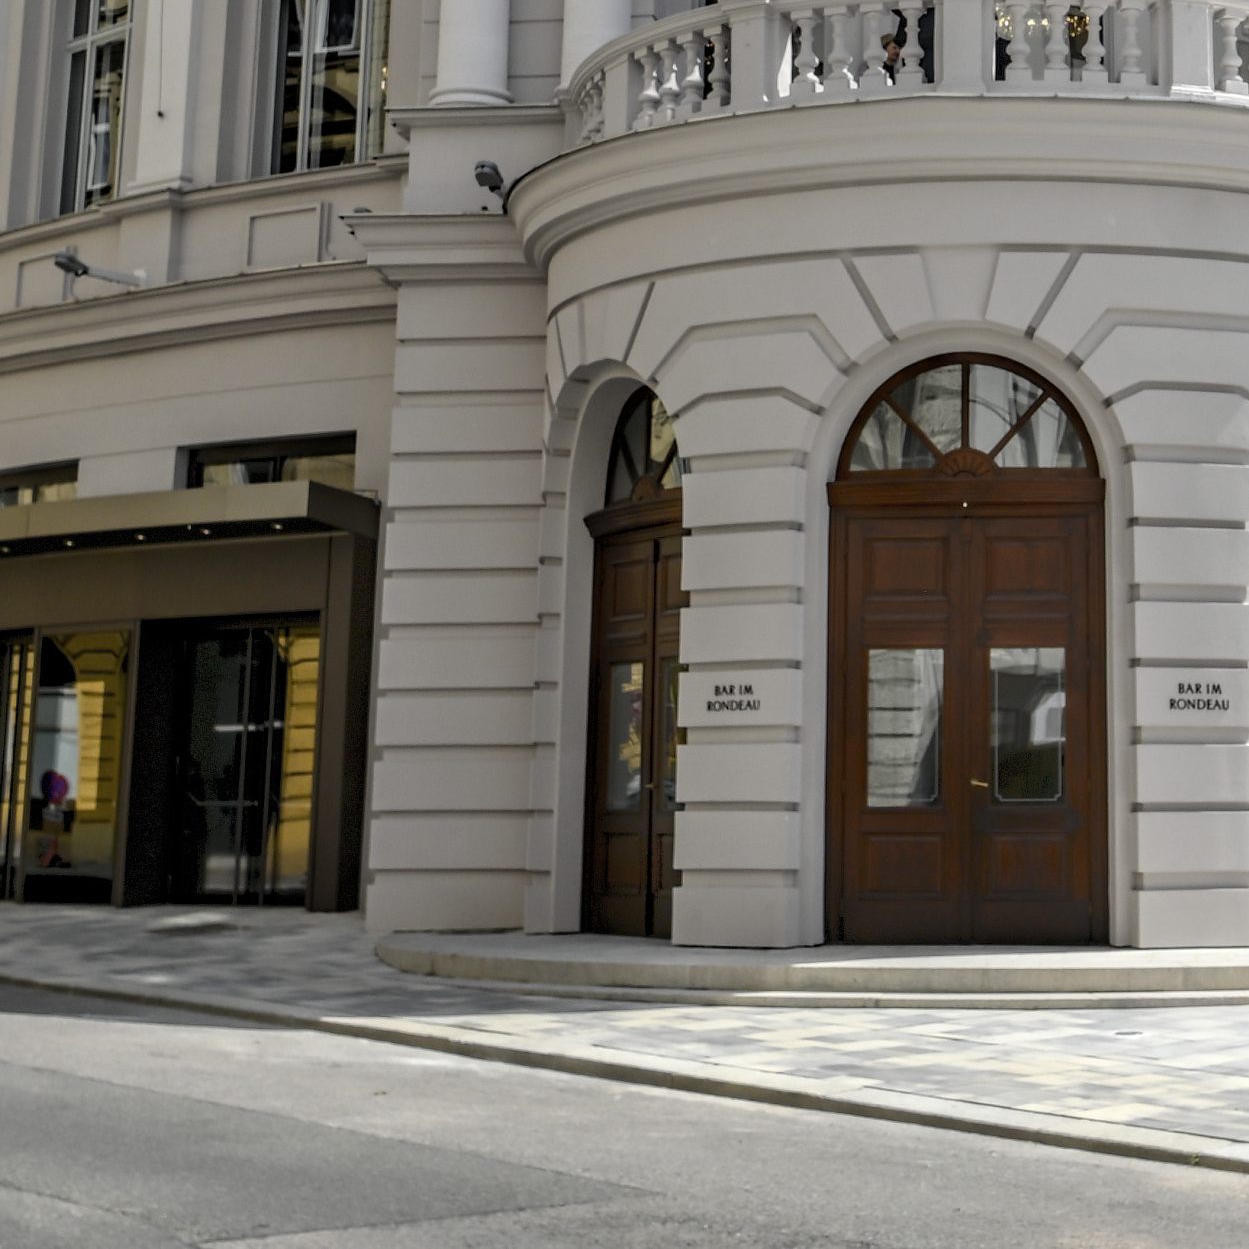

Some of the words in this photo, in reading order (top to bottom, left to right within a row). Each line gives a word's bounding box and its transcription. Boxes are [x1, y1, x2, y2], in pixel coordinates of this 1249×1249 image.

[714, 685, 736, 696] BAR
[739, 685, 753, 695] IM
[1178, 683, 1202, 694] BAR
[1206, 684, 1222, 694] IM
[706, 700, 761, 711] RONDEAU
[1169, 699, 1230, 710] RONDEAU
